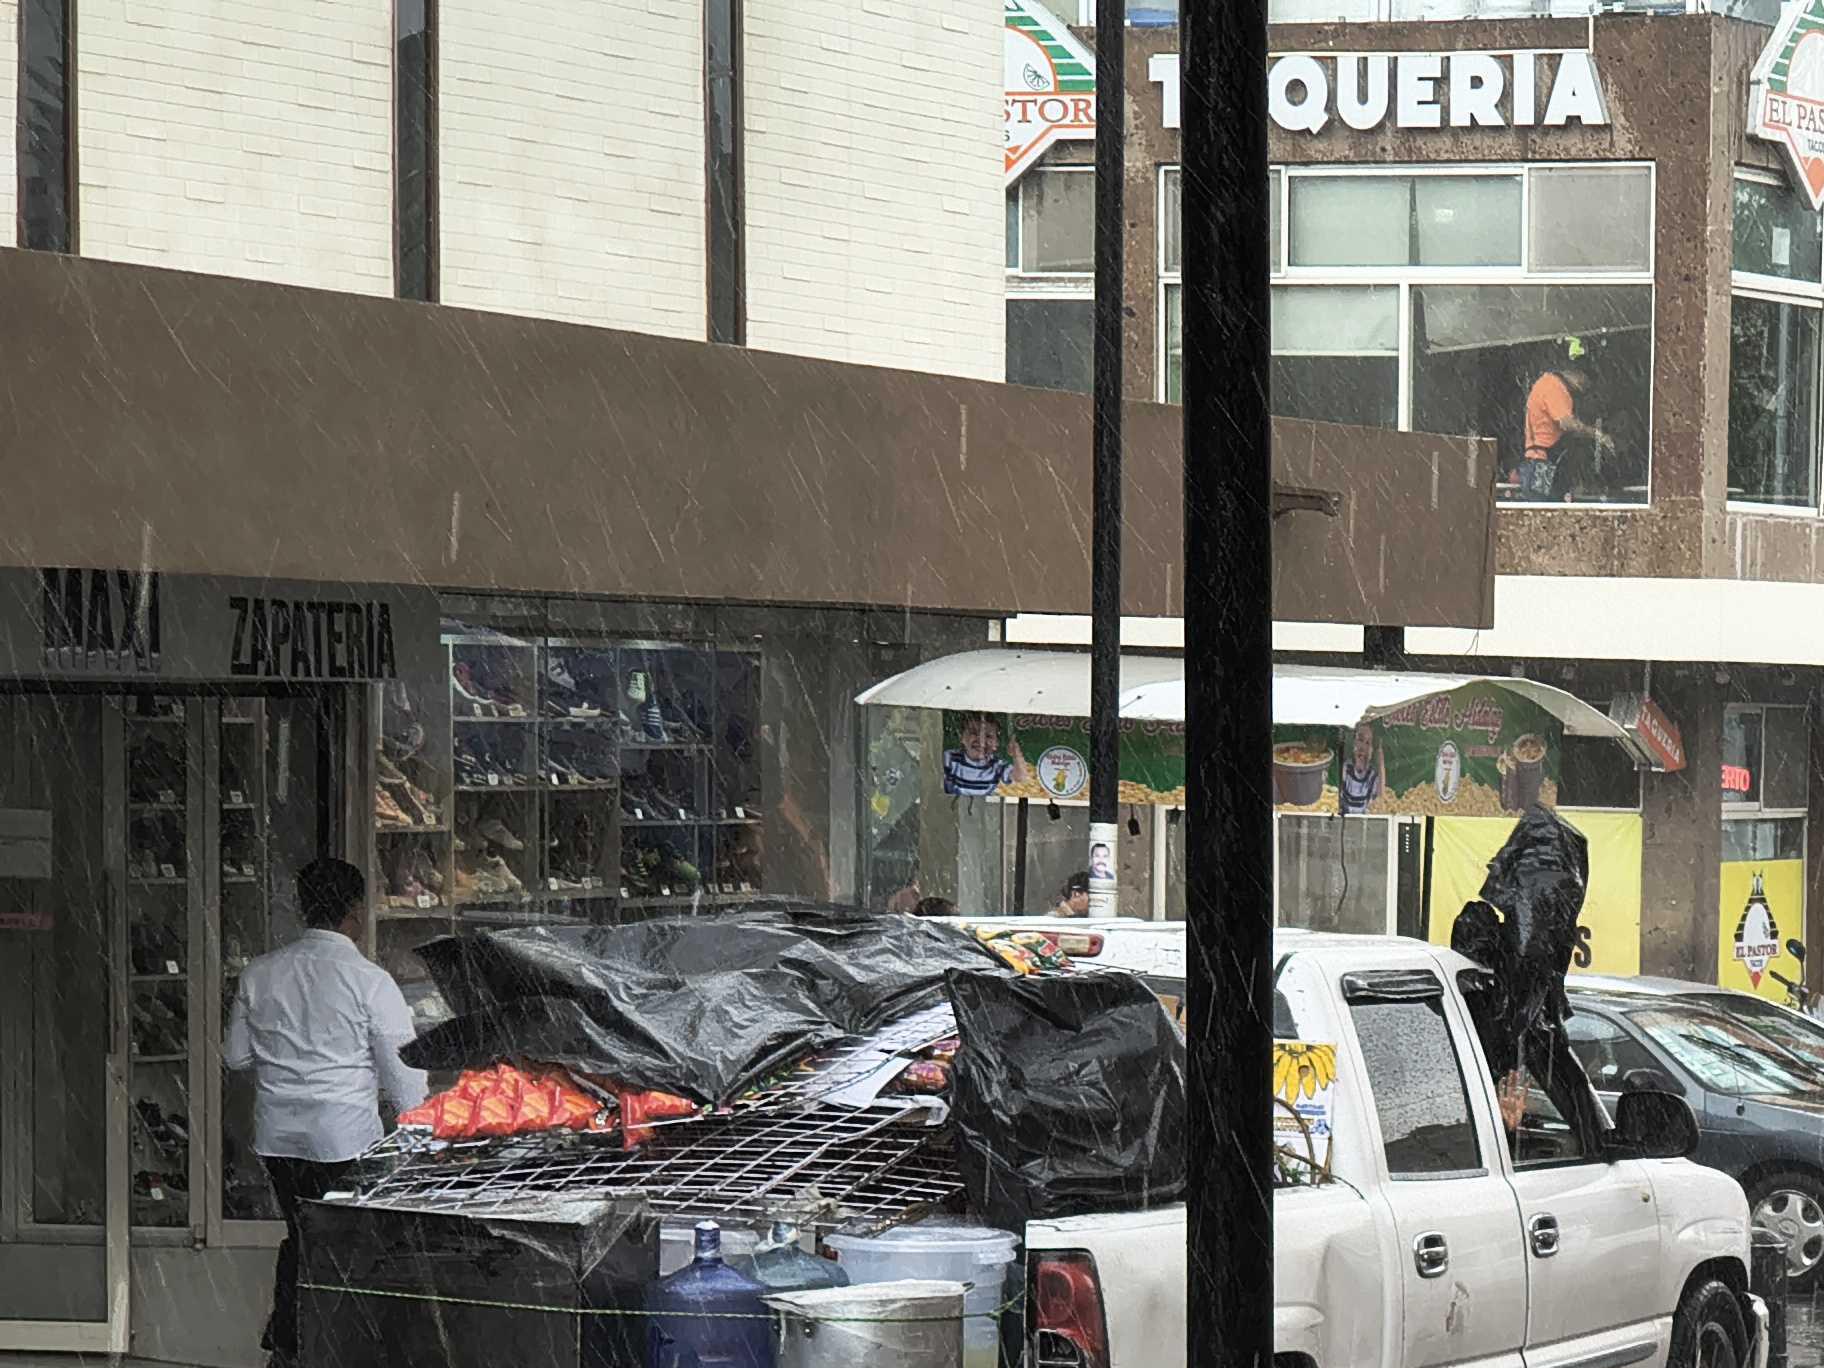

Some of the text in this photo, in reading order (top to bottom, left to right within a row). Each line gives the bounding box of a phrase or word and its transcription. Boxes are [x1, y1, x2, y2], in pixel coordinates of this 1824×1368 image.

[1148, 53, 1606, 134] TQUERIA
[1769, 97, 1794, 126] EL
[229, 596, 398, 680] ZAPATERIA
[1735, 943, 1777, 958] EL PASTOR
